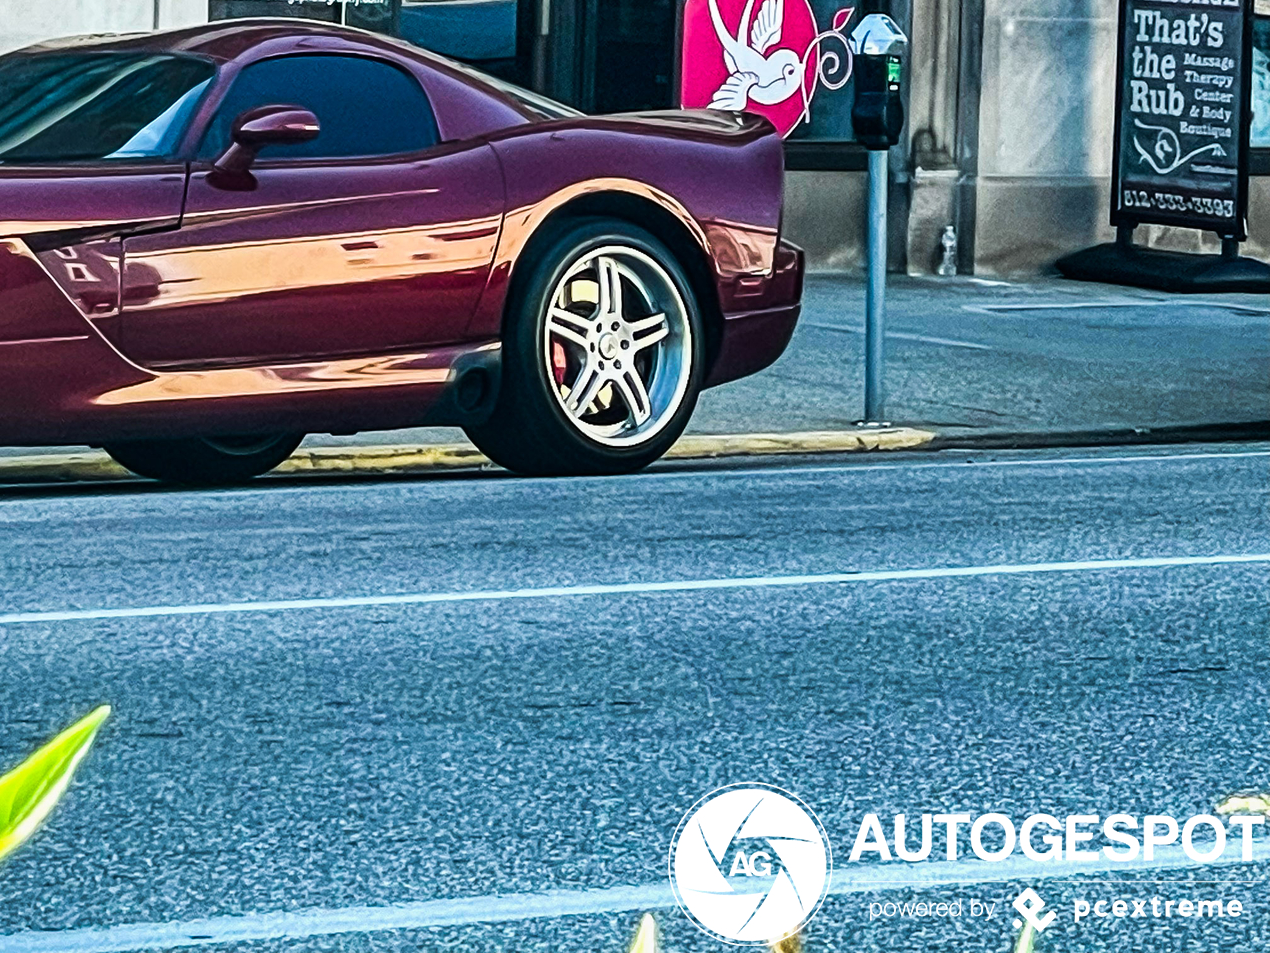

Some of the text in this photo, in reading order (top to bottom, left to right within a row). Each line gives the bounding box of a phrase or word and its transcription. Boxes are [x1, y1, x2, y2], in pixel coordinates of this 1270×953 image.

[1133, 9, 1224, 48] That's
[1132, 46, 1176, 80] the
[1183, 53, 1235, 71] Massage
[1183, 70, 1234, 88] Therapy
[1130, 80, 1185, 117] Rub
[1194, 88, 1234, 103] Center
[1190, 105, 1232, 123] & Body
[1179, 121, 1232, 138] Boutique
